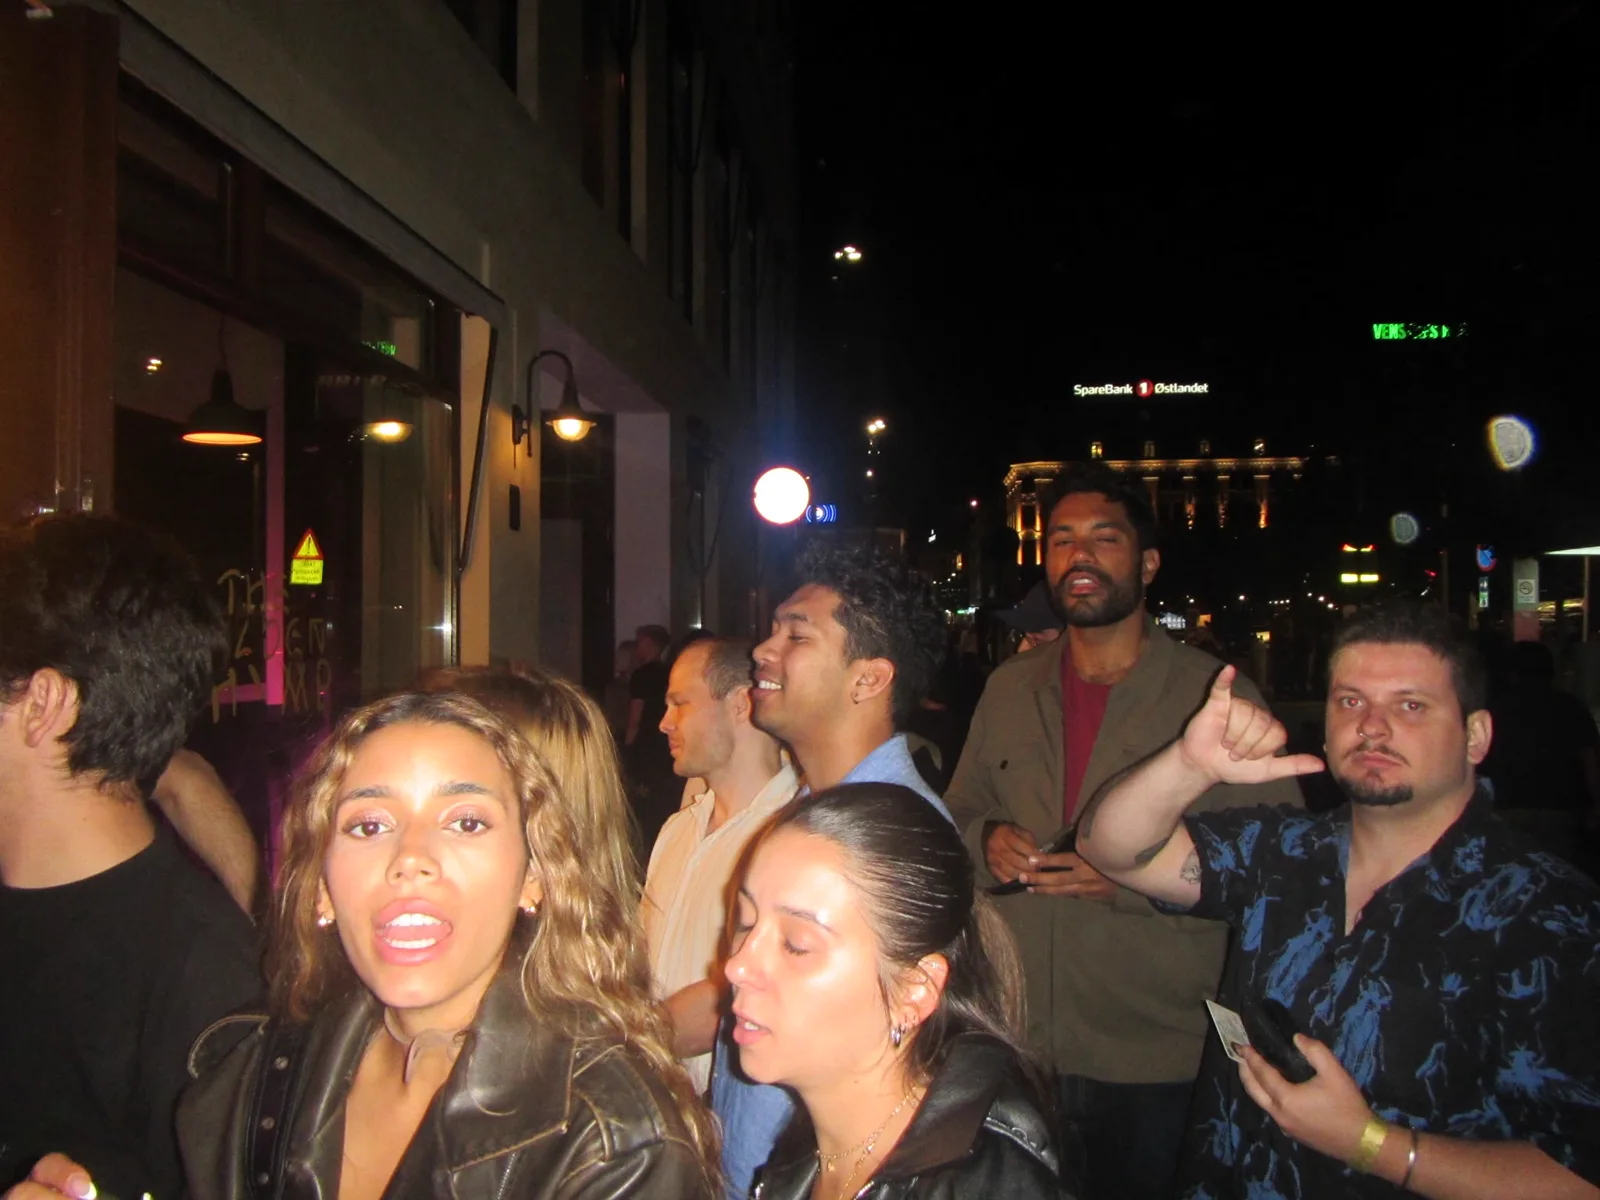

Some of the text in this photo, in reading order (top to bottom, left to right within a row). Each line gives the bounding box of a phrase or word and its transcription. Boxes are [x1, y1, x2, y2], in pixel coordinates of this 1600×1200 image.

[1073, 383, 1133, 397] SpareBank
[1154, 382, 1209, 394] Østlandet
[234, 617, 327, 661] LDEN
[211, 657, 332, 724] HIMP
